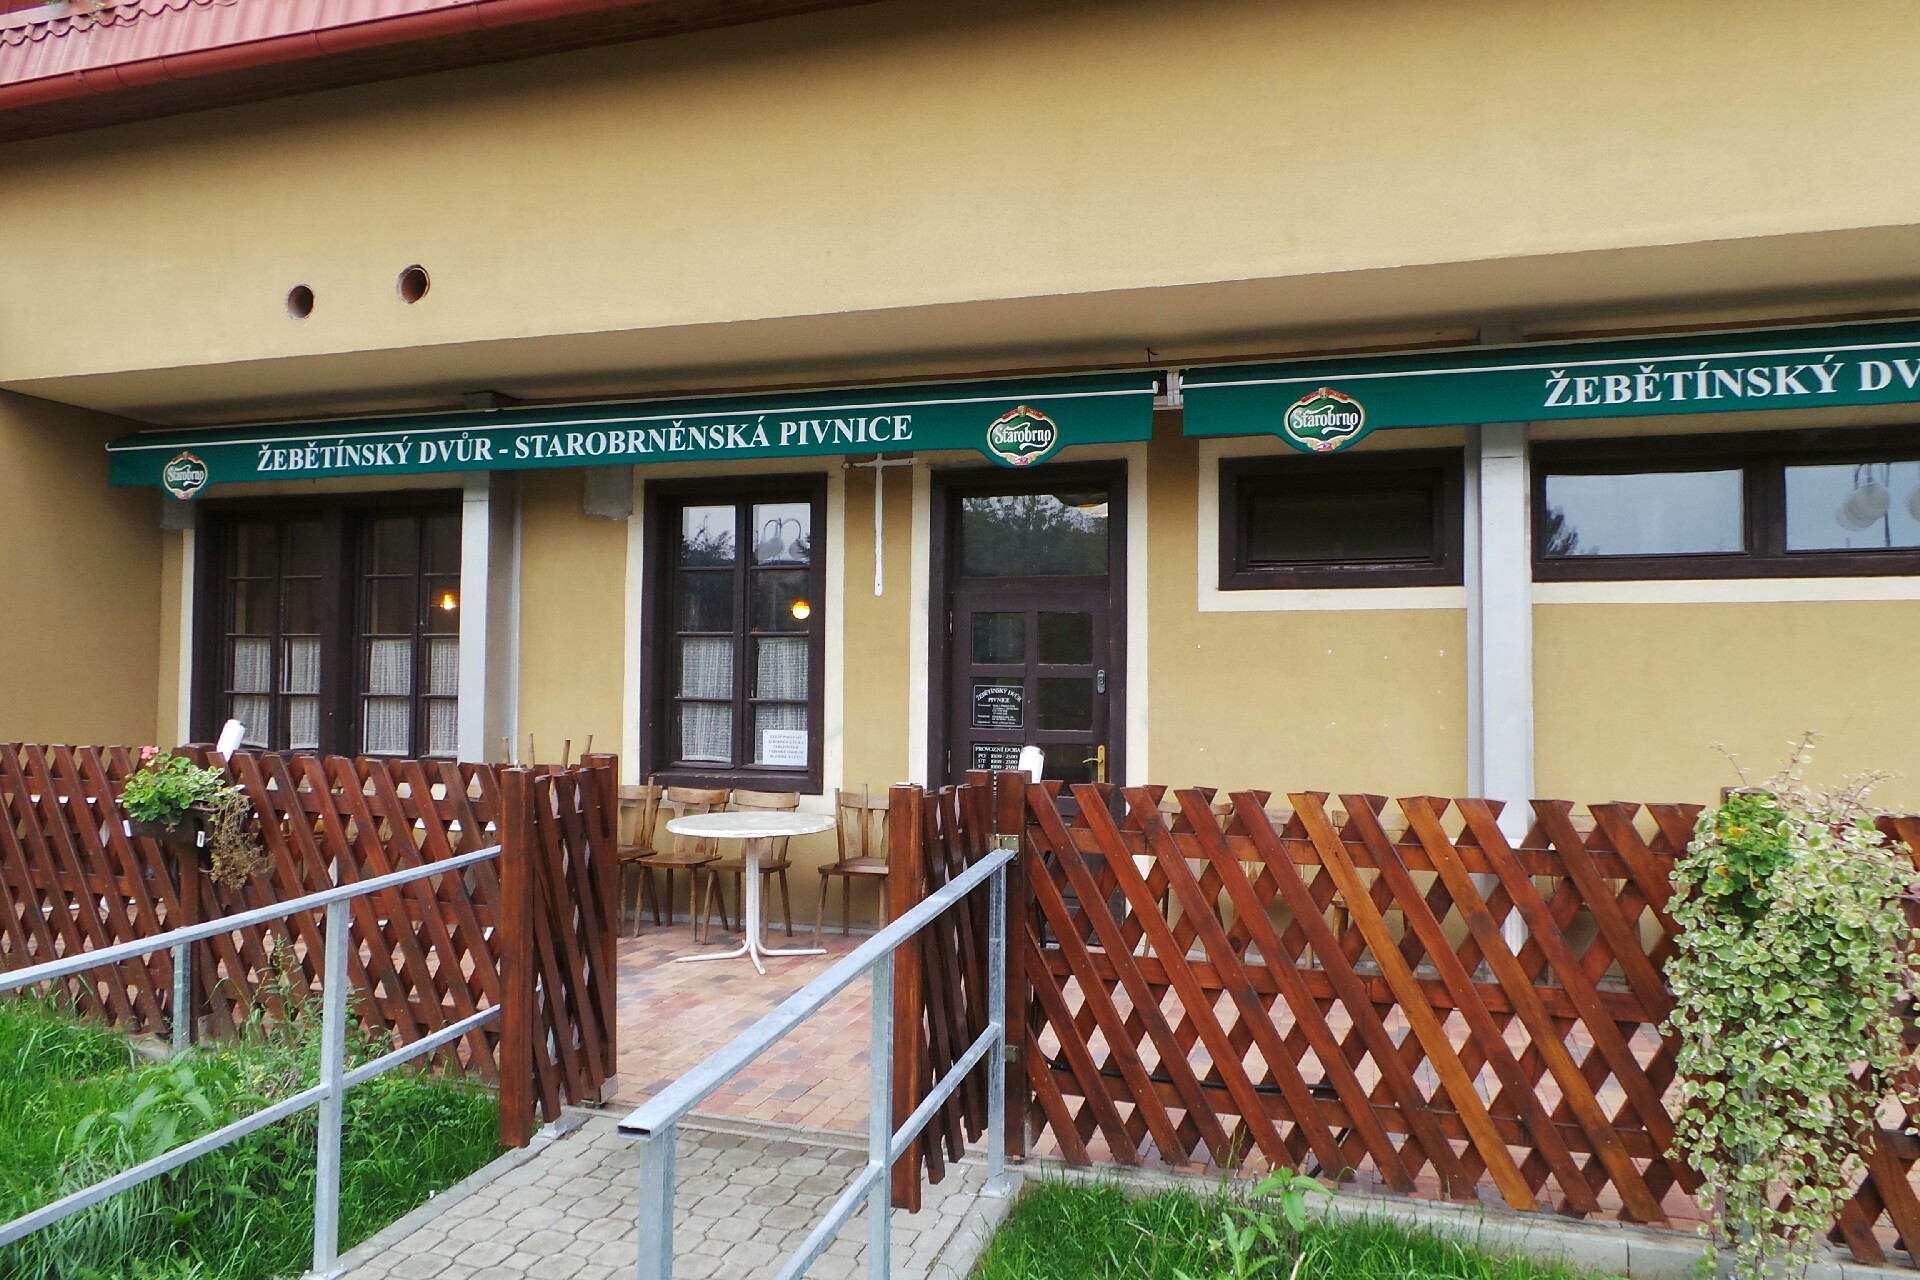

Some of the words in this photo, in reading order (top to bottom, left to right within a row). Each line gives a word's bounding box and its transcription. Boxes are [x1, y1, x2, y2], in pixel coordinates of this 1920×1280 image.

[1544, 354, 1845, 407] ŽEBĚTÍNSKÝ
[994, 422, 1052, 450] Starobrno
[1293, 405, 1359, 435] Starobrno
[257, 436, 413, 471] ŽEBĚTÍNSKÝ
[417, 431, 494, 465] DVŮR
[514, 416, 771, 459] STAROBRNĚNSKÁ
[778, 414, 914, 446] PIVNICE
